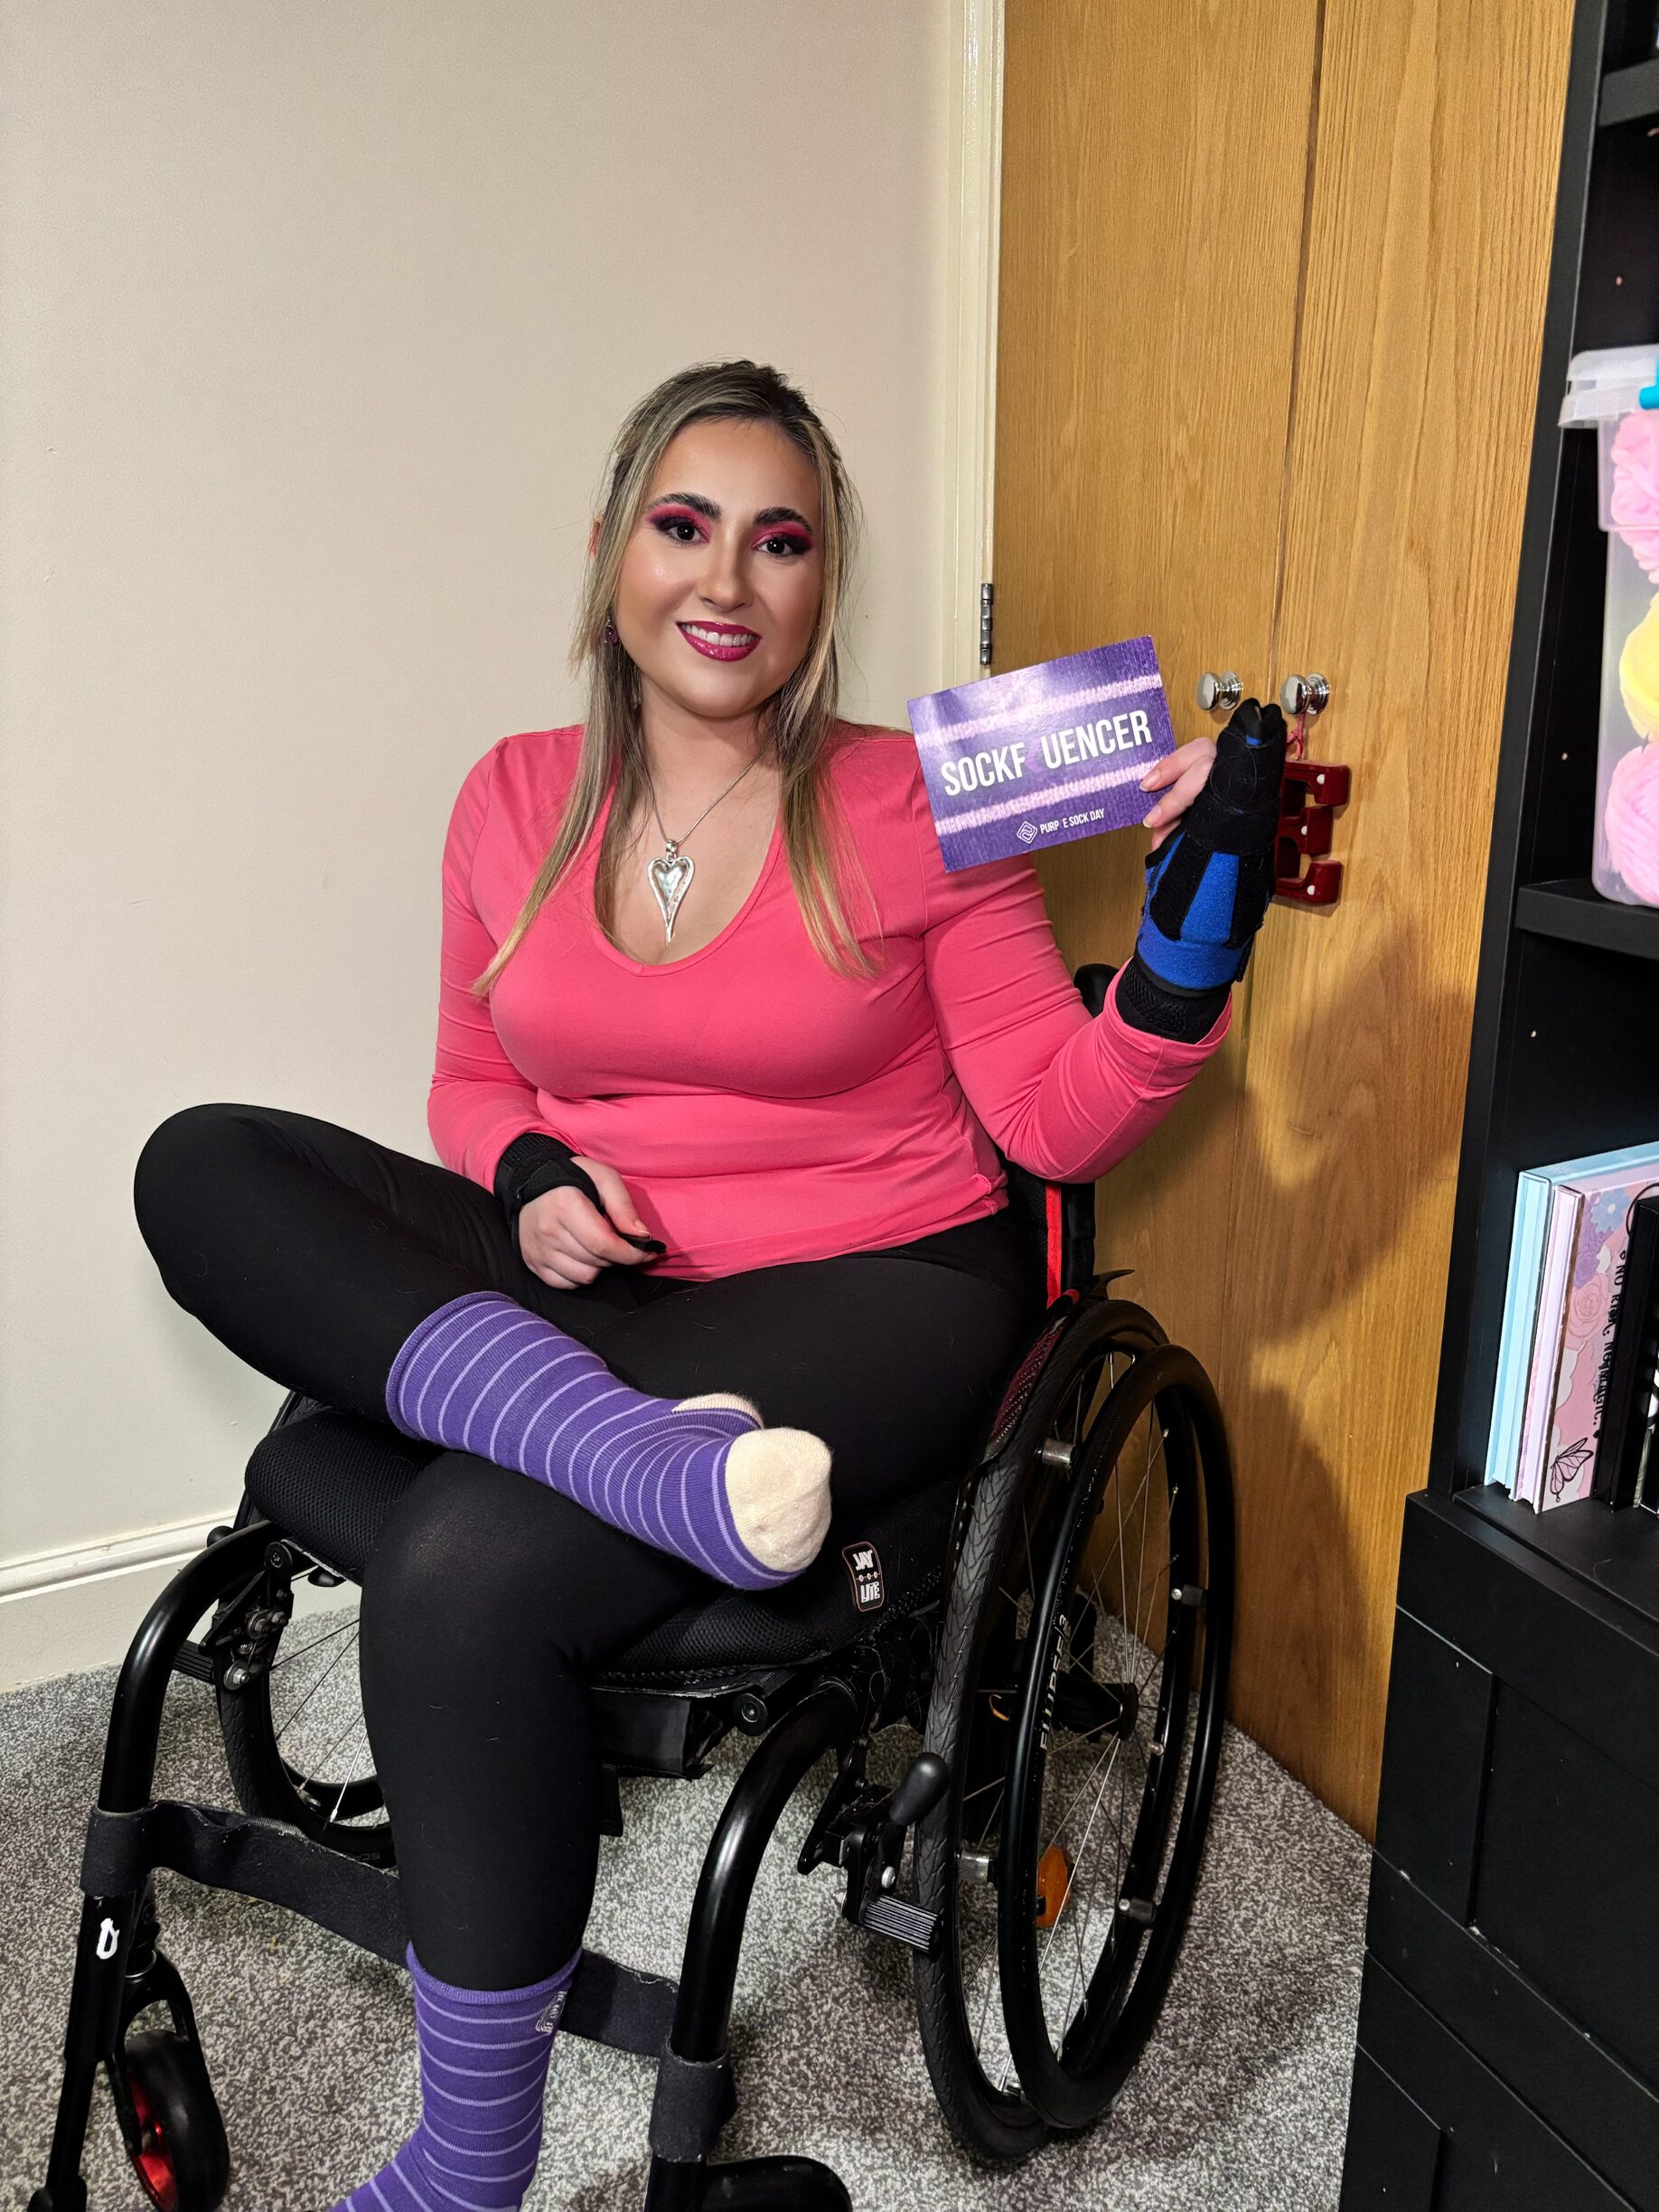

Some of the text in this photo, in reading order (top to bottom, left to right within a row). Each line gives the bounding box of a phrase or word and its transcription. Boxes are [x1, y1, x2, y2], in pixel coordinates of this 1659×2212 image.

[941, 709, 1153, 797] SOCKFUENCER
[1039, 808, 1105, 834] PURPE SOCK DAY
[852, 1549, 874, 1570] JAY
[860, 1580, 880, 1603] LITE
